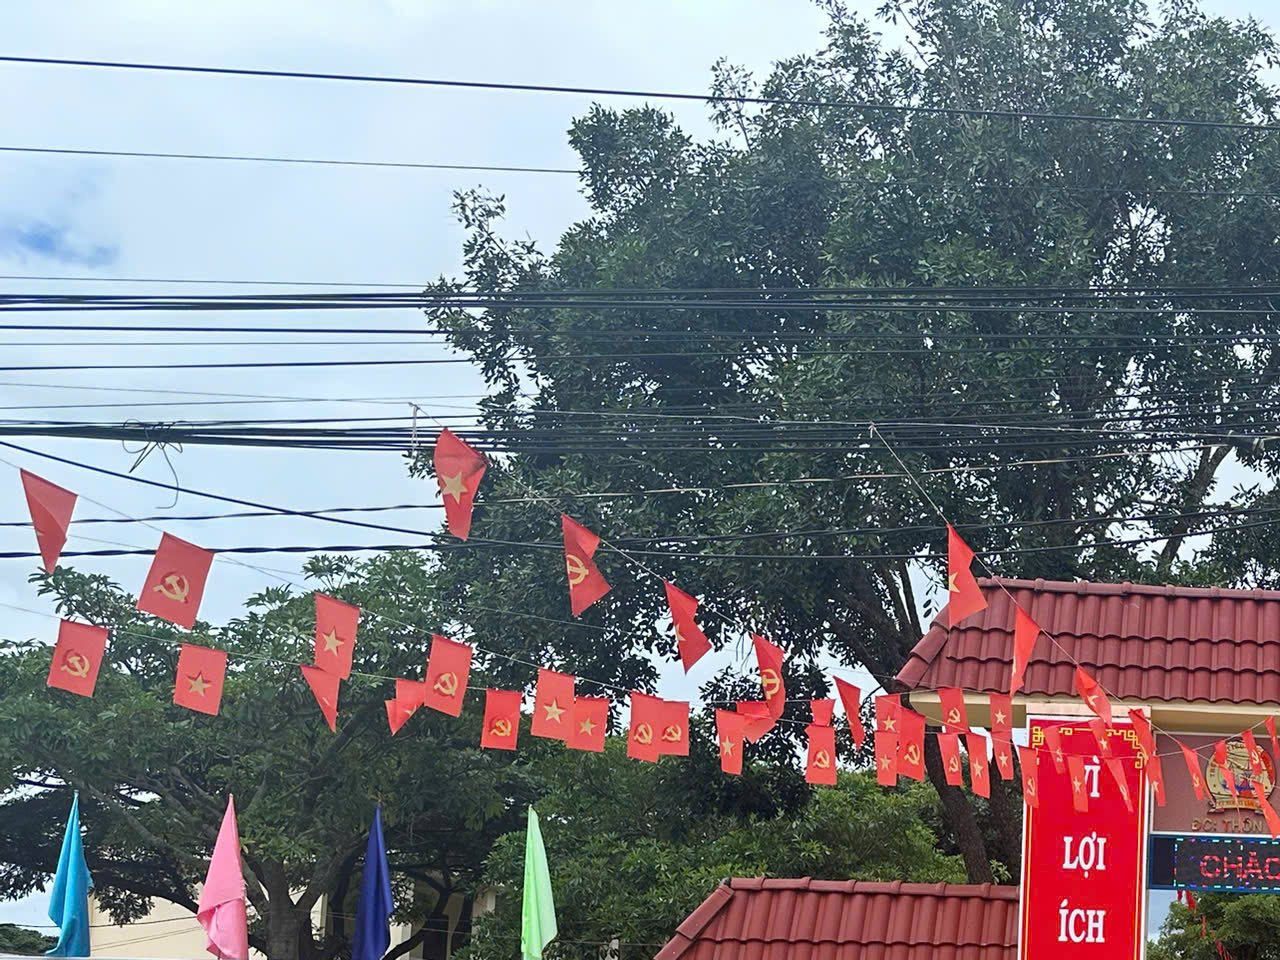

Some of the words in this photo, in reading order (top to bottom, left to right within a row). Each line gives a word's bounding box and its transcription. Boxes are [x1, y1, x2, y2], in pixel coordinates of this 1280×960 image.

[1222, 817, 1264, 834] THÔN
[1062, 831, 1107, 879] LỢI
[1058, 898, 1106, 943] ÍCH
